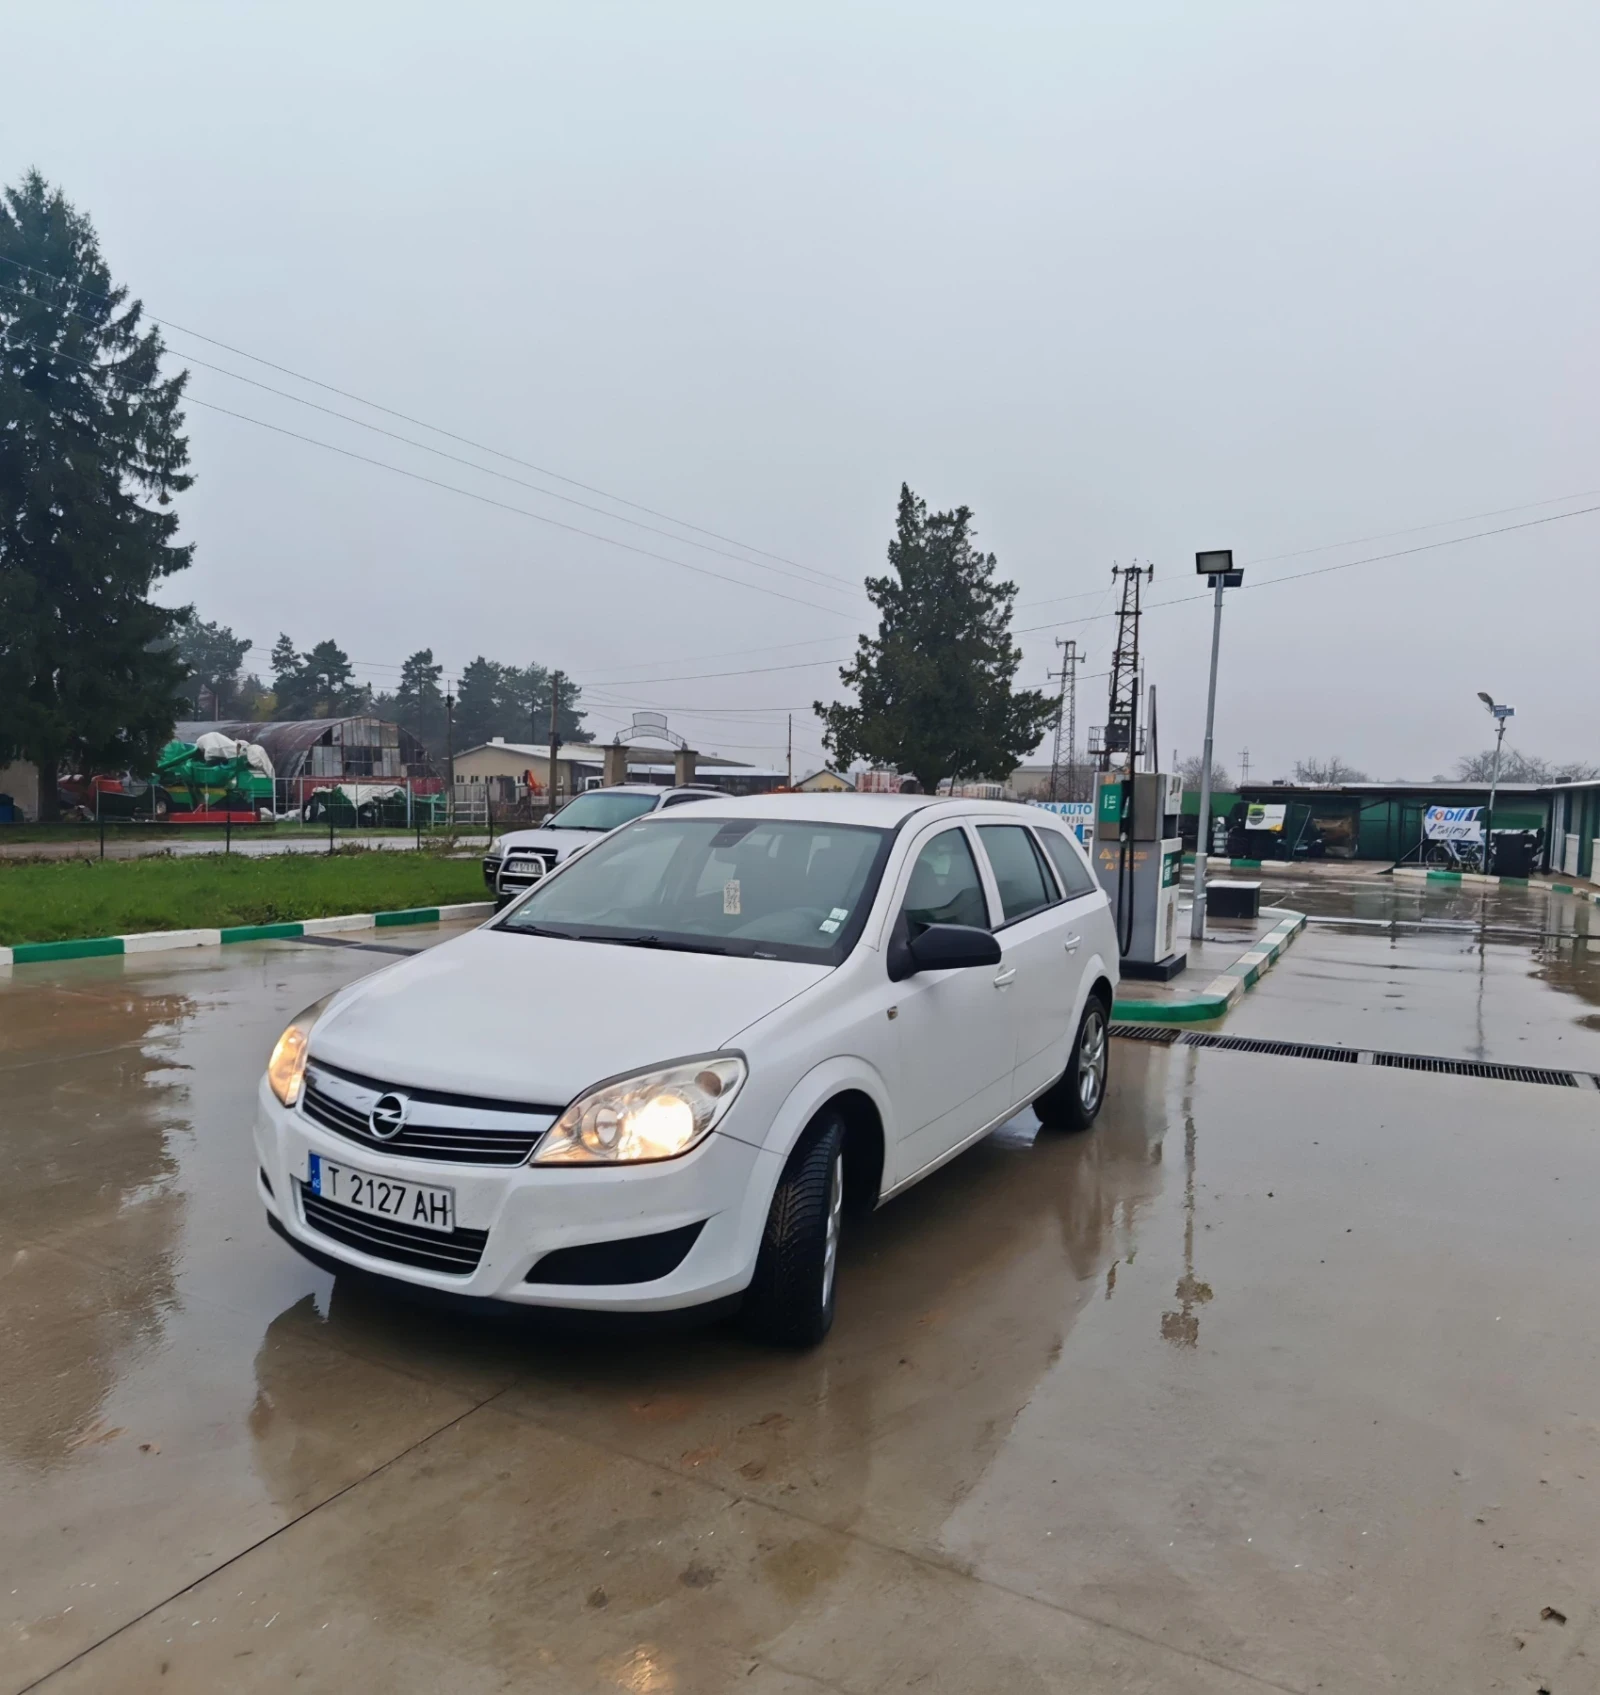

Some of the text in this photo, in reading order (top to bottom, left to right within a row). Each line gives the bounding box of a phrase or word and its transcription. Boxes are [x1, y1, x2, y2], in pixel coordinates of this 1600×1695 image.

[1060, 804, 1093, 815] AUTO
[328, 1166, 448, 1226] T 2127 AH
